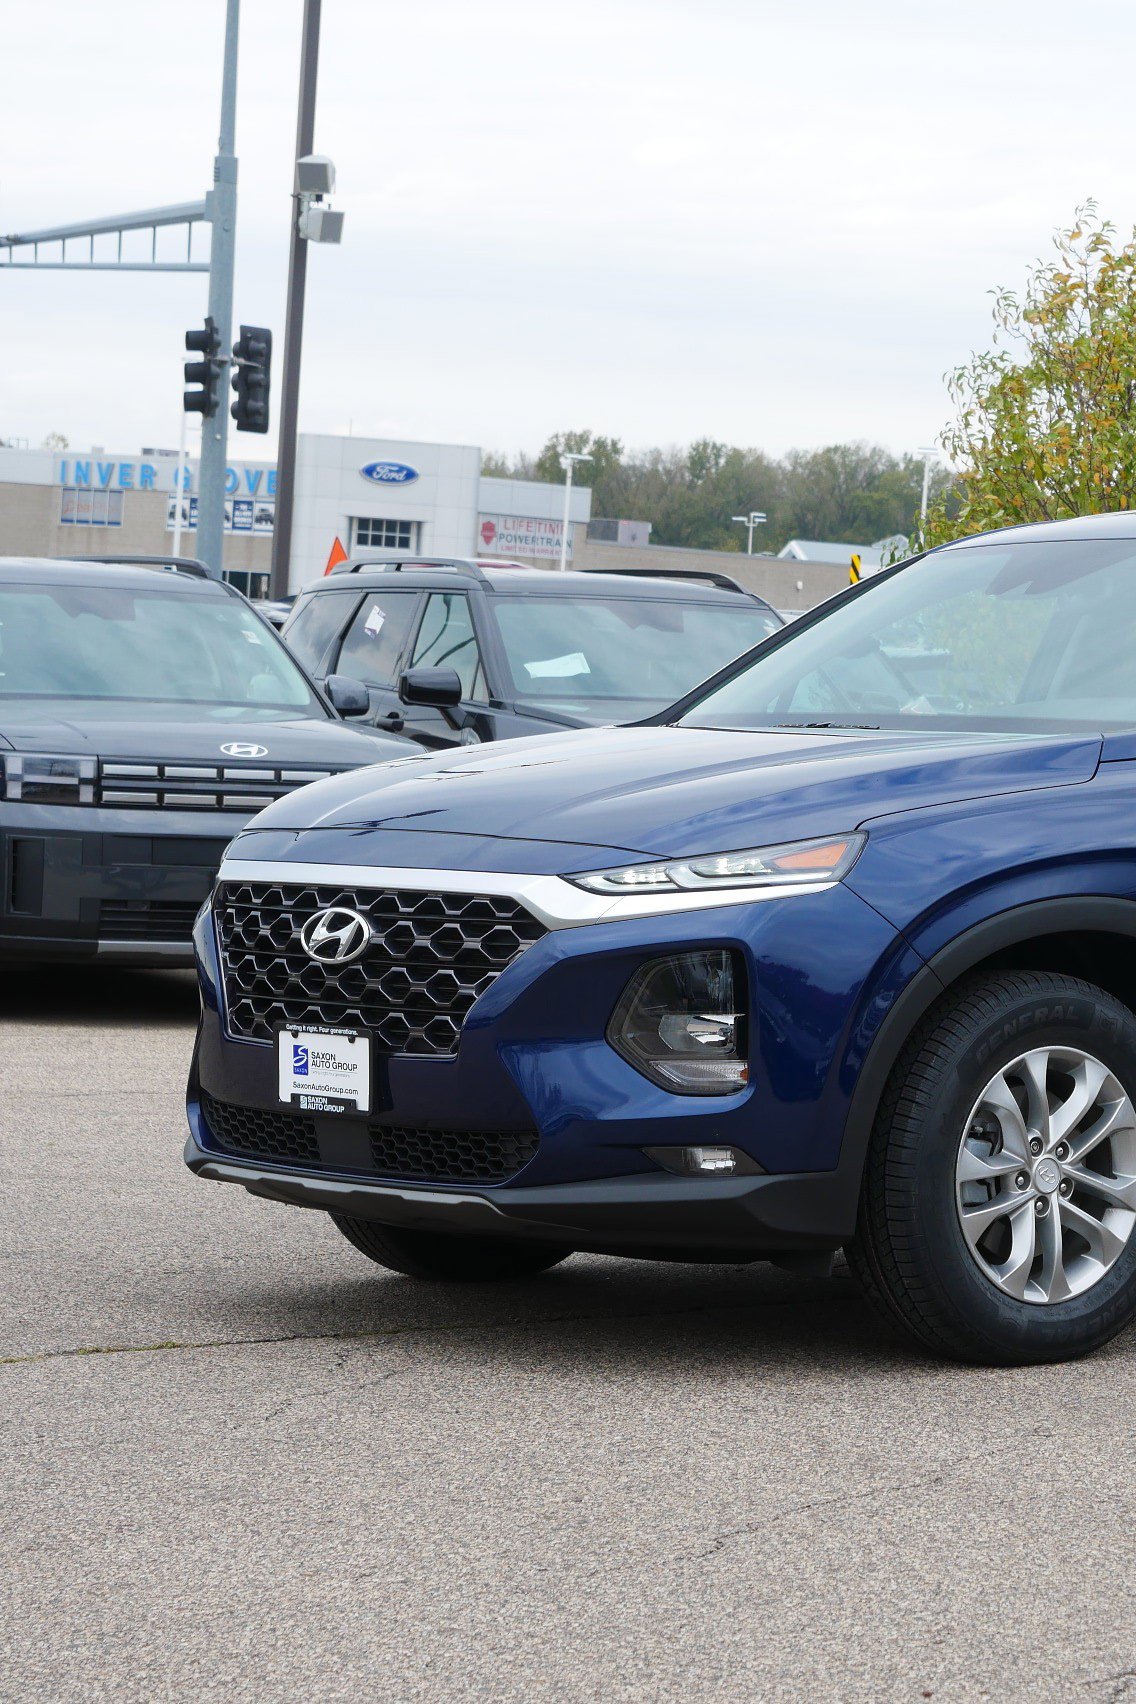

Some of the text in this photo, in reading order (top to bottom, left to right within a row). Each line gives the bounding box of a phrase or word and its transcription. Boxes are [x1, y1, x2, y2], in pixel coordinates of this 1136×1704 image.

[60, 460, 278, 496] INVER GOVE
[372, 464, 408, 481] Ford
[499, 533, 572, 549] POWERTRAN
[286, 1023, 302, 1032] Getting
[307, 1025, 318, 1033] right.
[330, 1028, 358, 1036] generations.
[976, 1005, 1080, 1066] GENERAL
[311, 1051, 336, 1061] SAXON
[311, 1060, 358, 1072] AUTO GROUP
[293, 1081, 359, 1095] SaxonAutoGroup.com
[307, 1095, 328, 1105] SAXON
[307, 1103, 345, 1113] AUTO GROUP
